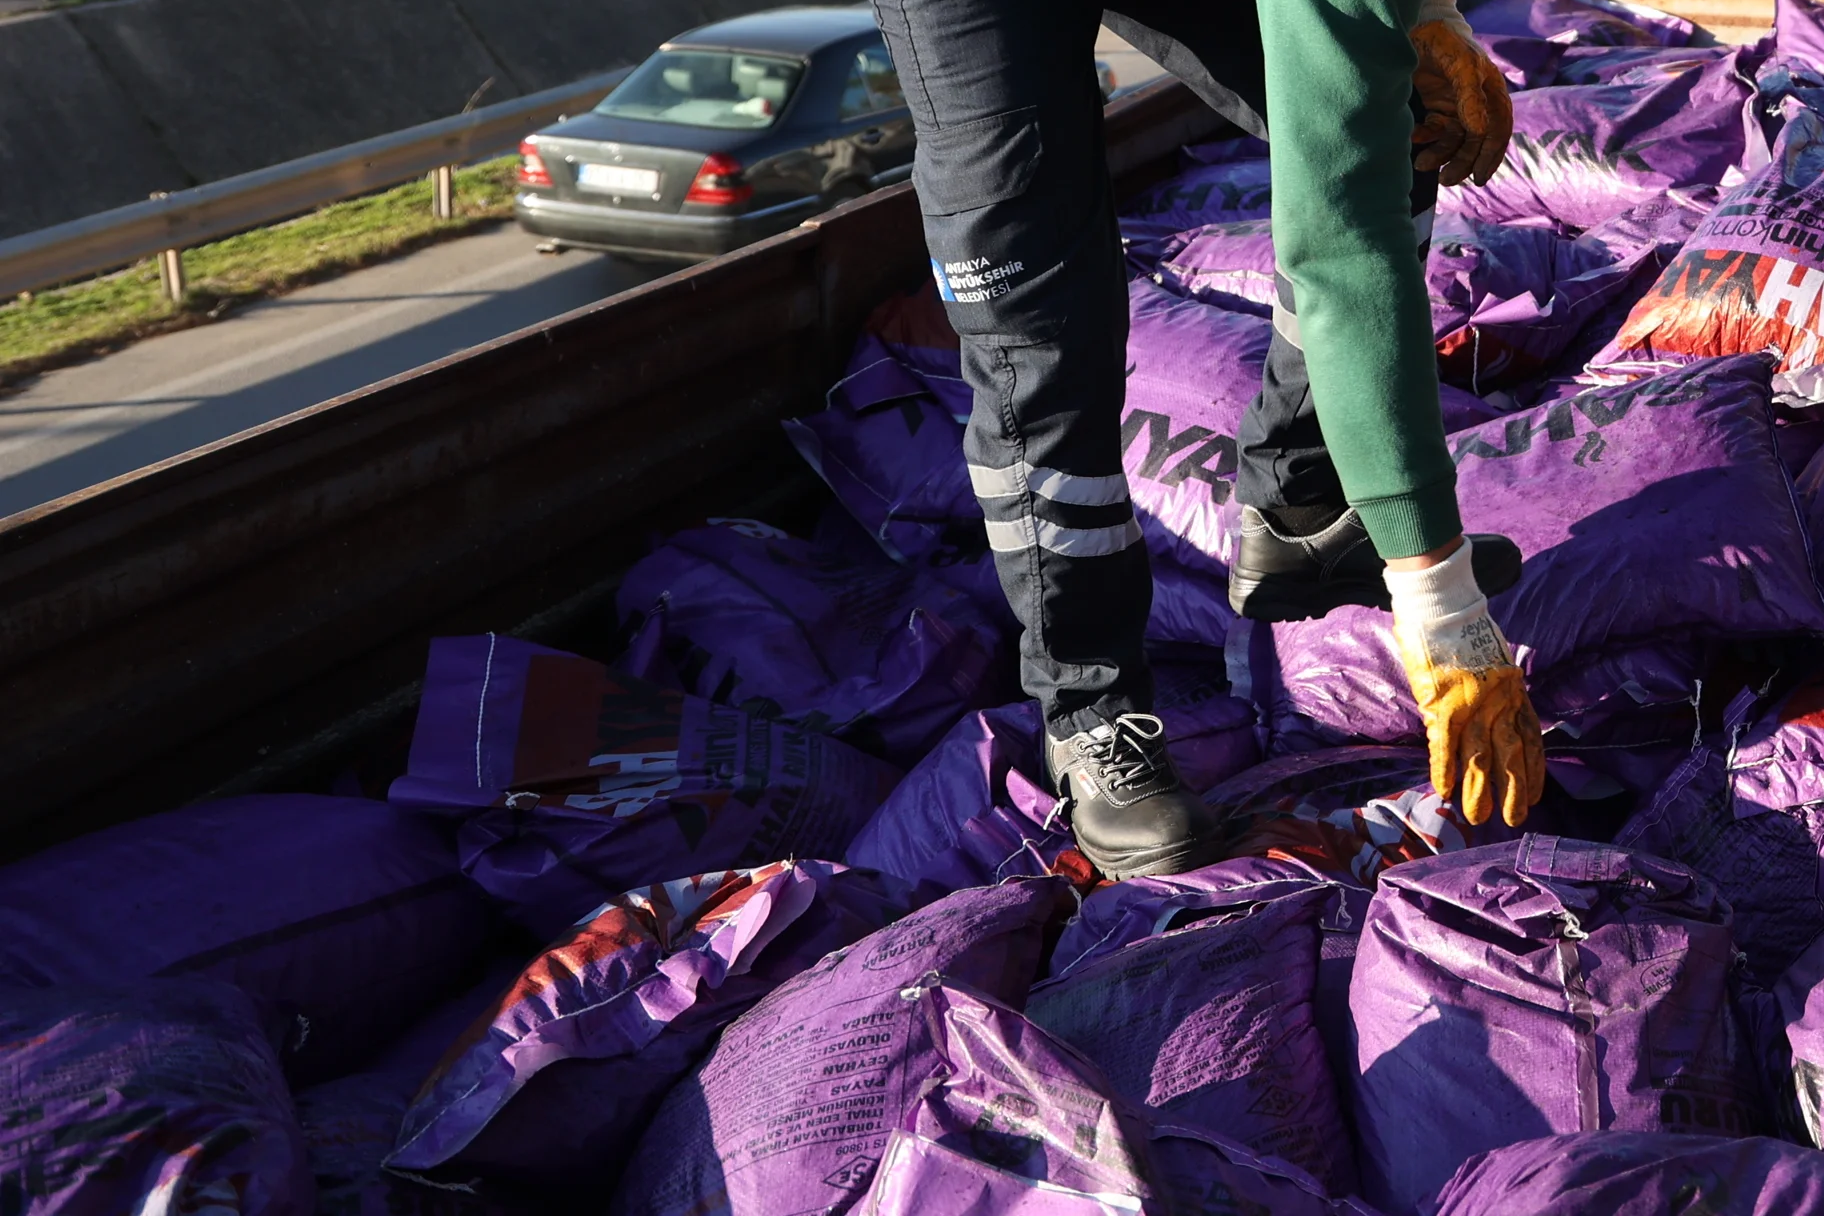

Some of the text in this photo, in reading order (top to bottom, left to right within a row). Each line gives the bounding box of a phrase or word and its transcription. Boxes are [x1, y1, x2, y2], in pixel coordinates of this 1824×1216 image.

[945, 256, 991, 274] ANTALYA
[948, 260, 1025, 290] BÜYÜKŞEHİR
[954, 279, 1011, 303] BELEDİYESİ
[1470, 633, 1493, 651] KN2
[822, 1054, 890, 1076] CEYHAN
[830, 1076, 887, 1097] PAYAS
[1188, 1074, 1206, 1085] VE
[817, 1094, 886, 1114] KÖMÜRÜN
[805, 1113, 841, 1125] EDEN
[844, 1107, 885, 1121] İTHAL
[788, 1122, 803, 1134] VE
[793, 1120, 883, 1145] TORBALAYAN
[835, 1142, 869, 1157] 13809
